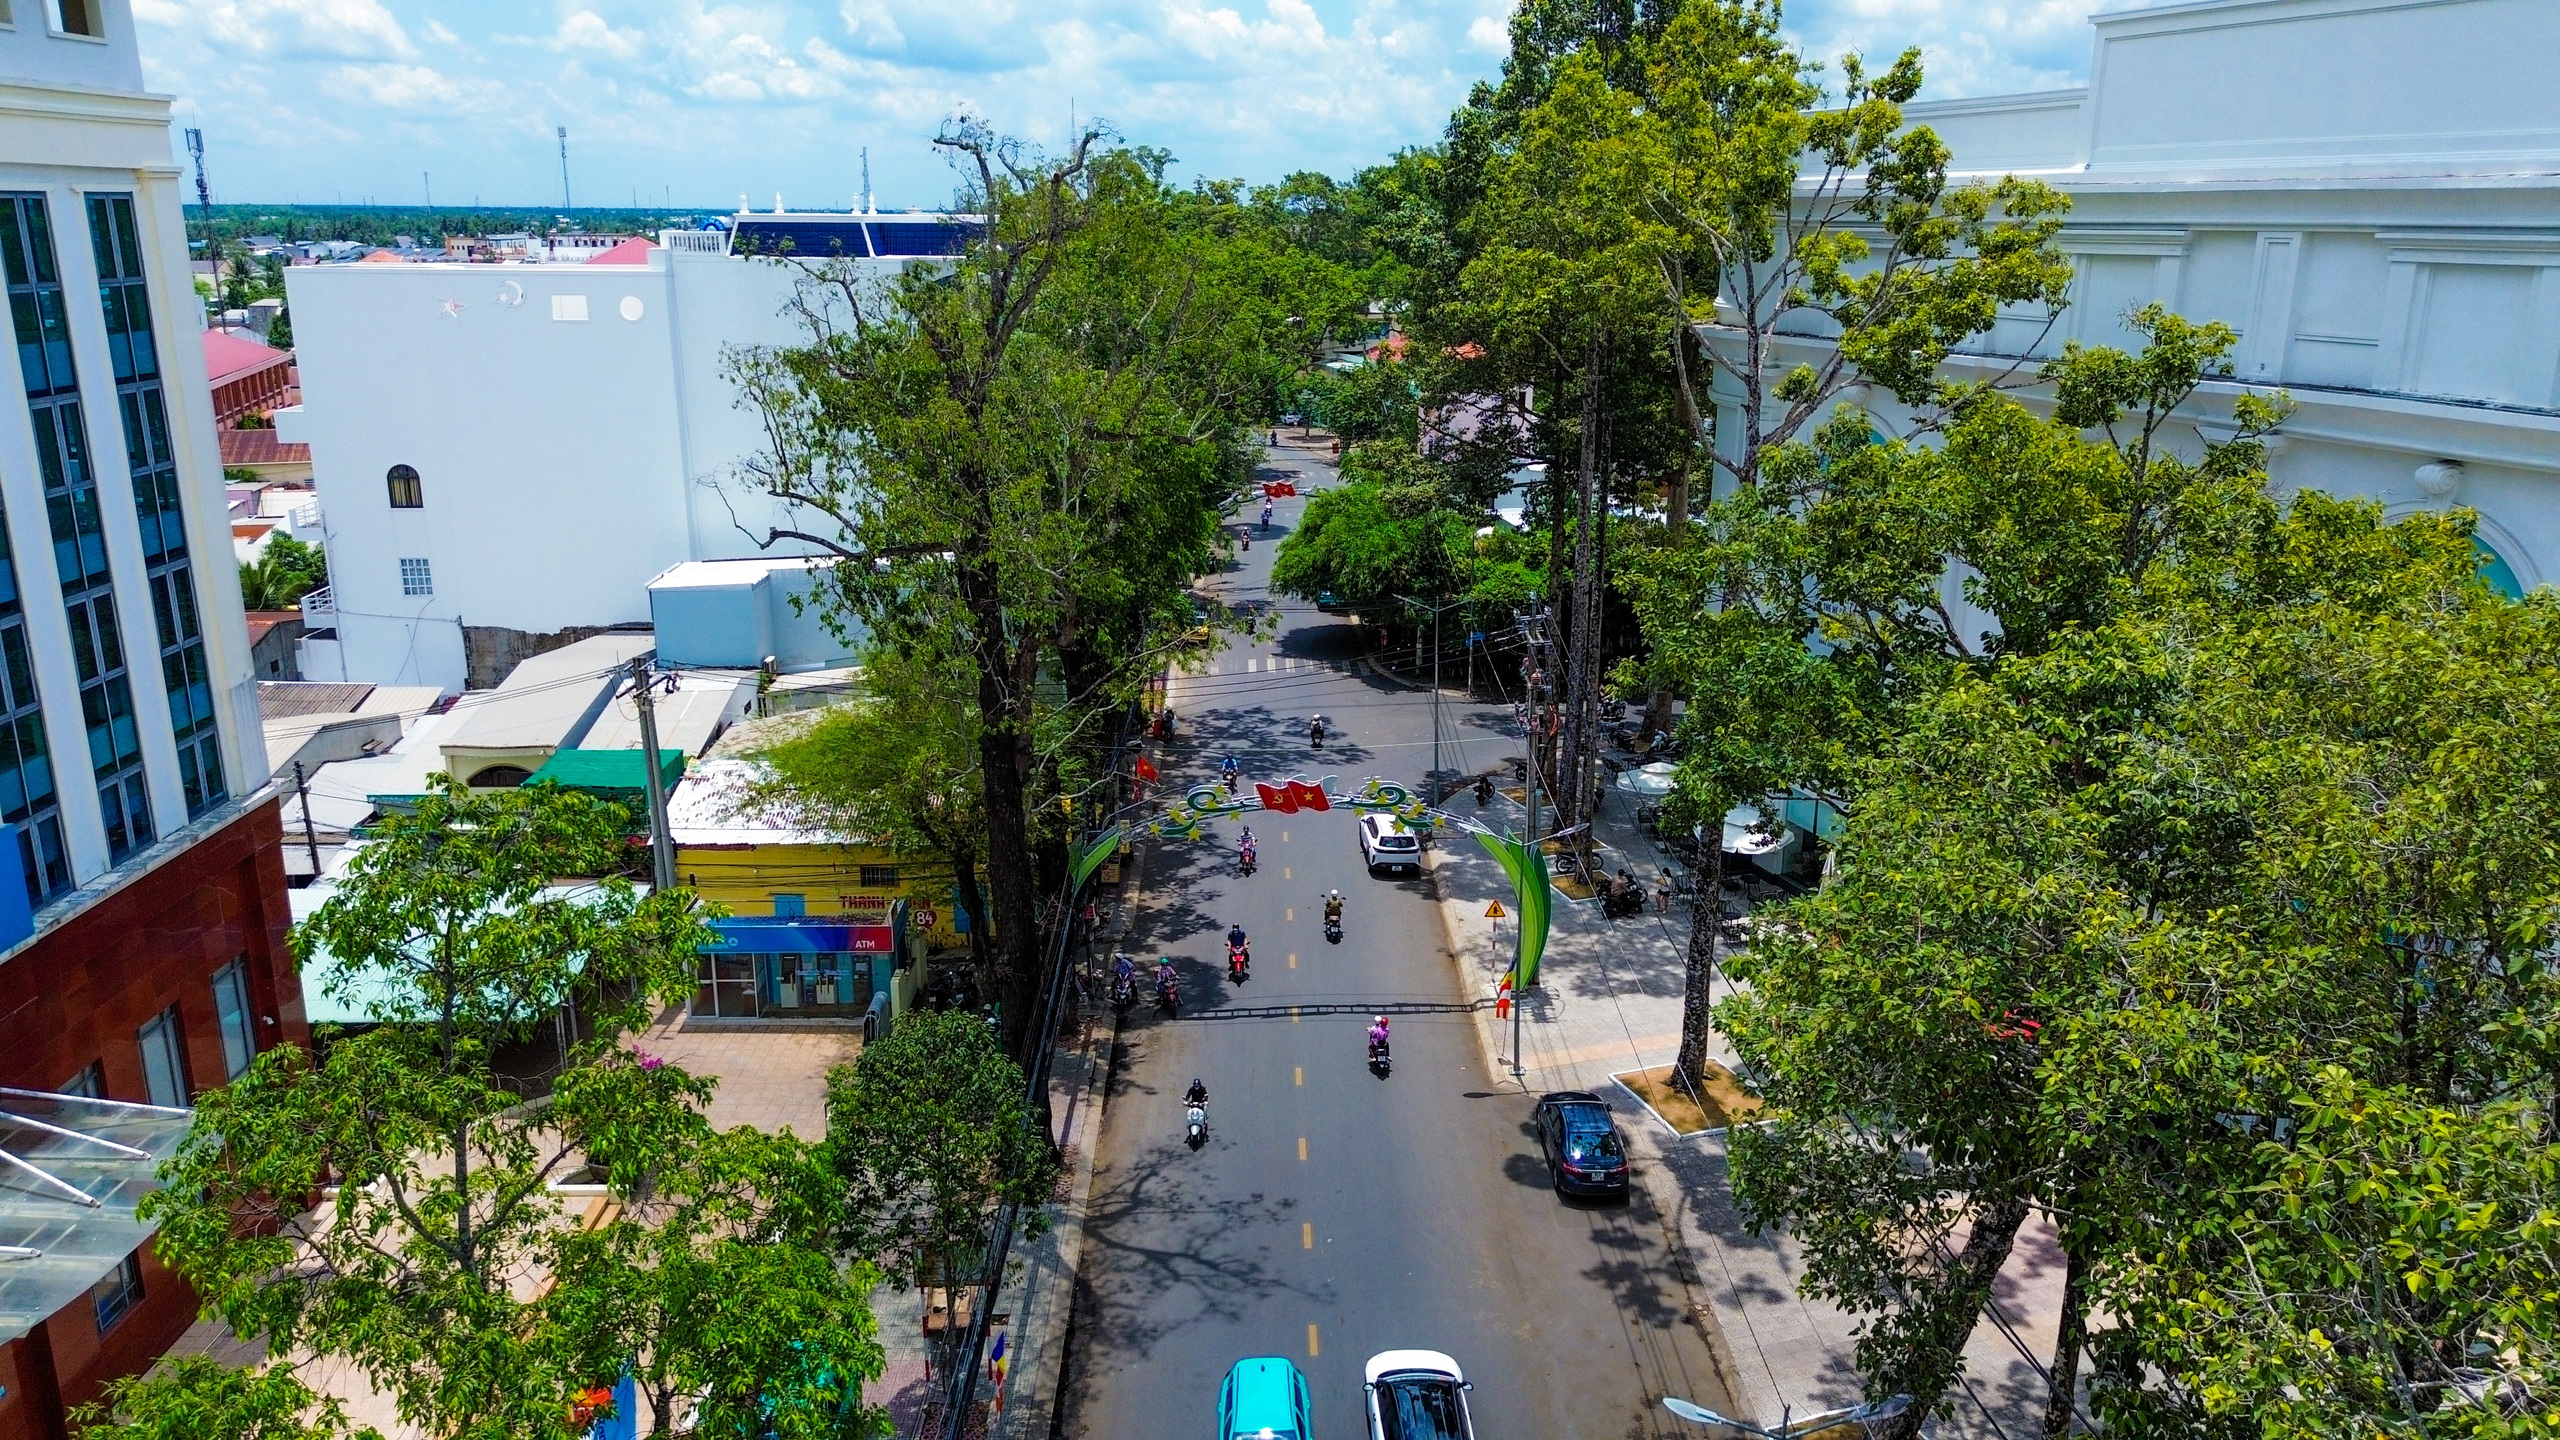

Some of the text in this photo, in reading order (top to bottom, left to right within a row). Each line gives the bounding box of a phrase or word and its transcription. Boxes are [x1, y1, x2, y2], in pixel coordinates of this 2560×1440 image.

[839, 895, 886, 909] THANH
[916, 911, 933, 925] 84
[855, 940, 875, 948] ATM
